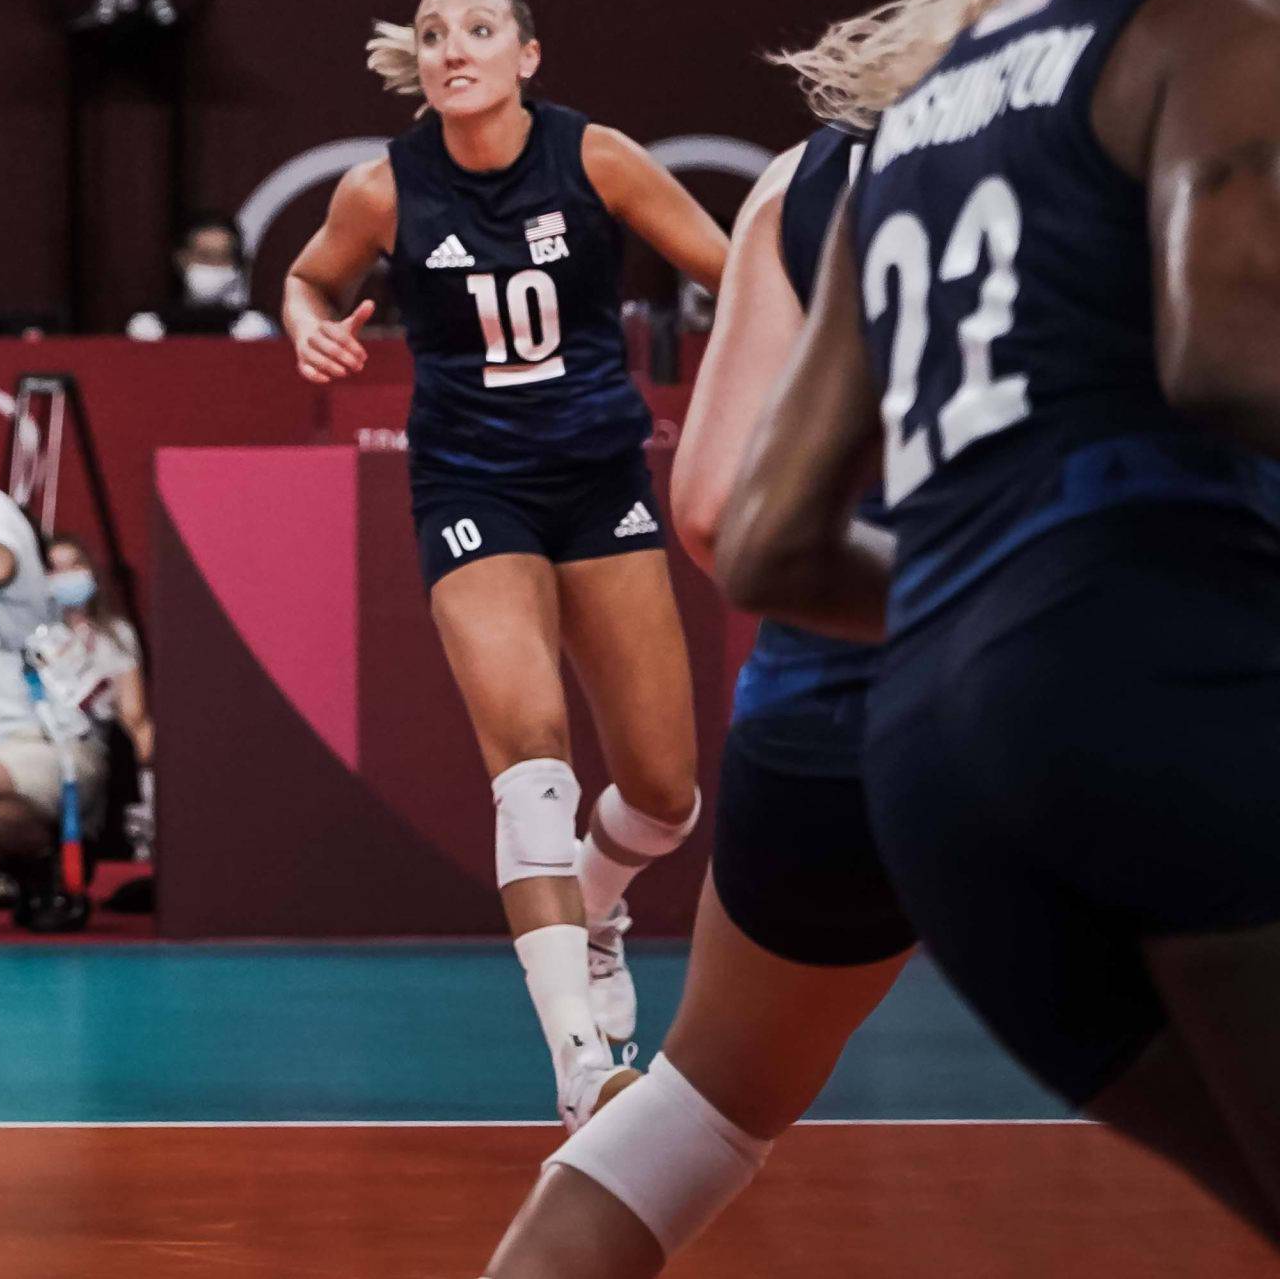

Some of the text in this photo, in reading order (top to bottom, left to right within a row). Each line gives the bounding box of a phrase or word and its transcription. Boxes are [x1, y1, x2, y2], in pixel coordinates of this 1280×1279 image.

[528, 235, 571, 266] USA
[466, 268, 562, 364] 10
[862, 173, 1032, 510] 22
[442, 517, 483, 559] 10
